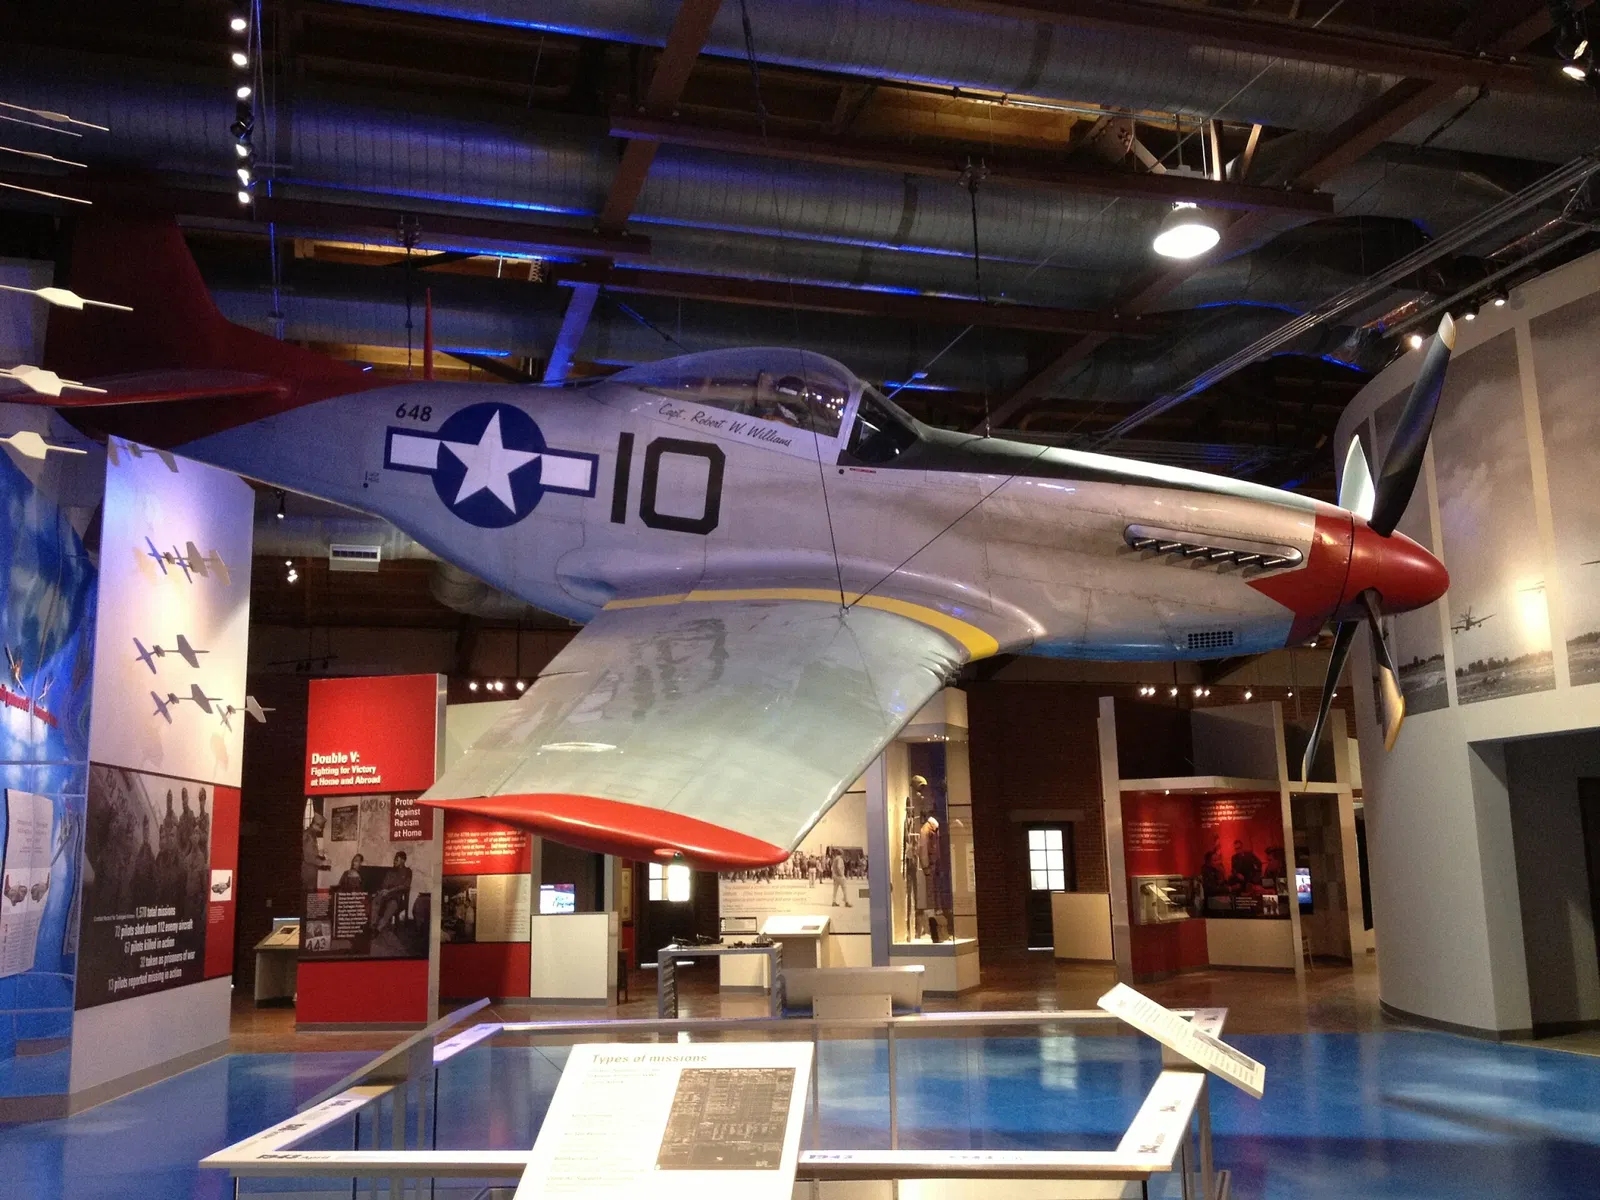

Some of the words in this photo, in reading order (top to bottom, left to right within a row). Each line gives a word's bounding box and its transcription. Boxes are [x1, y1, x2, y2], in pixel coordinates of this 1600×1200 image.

[396, 402, 432, 422] 648
[658, 403, 686, 420] Capt.
[690, 410, 726, 429] Robert
[728, 420, 747, 434] W.
[747, 426, 792, 447] Williams
[610, 432, 726, 535] 10
[311, 752, 348, 764] Double
[350, 751, 360, 762] V:
[310, 766, 339, 777] Fighting
[340, 766, 350, 774] for
[352, 765, 376, 774] Victory
[319, 778, 340, 786] Home
[340, 776, 354, 785] and
[355, 776, 381, 784] Abroad
[395, 798, 417, 806] Prote
[395, 808, 420, 818] Against
[394, 819, 419, 827] Racism
[402, 829, 422, 837] Home
[147, 906, 157, 918] total
[158, 905, 176, 916] missions
[121, 924, 134, 940] pilots
[135, 923, 145, 935] shot
[145, 922, 157, 934] down
[165, 922, 178, 933] enemy
[179, 918, 193, 930] aircraft
[130, 939, 144, 956] pilots
[144, 938, 156, 950] killed
[157, 938, 162, 948] in
[162, 936, 175, 948] action
[146, 955, 158, 967] taken
[158, 956, 164, 964] as
[164, 952, 182, 967] prisoners
[183, 950, 188, 960] of
[114, 977, 128, 993] pilots
[128, 972, 148, 989] reported
[148, 970, 164, 982] missing
[165, 970, 169, 979] in
[169, 968, 182, 978] action
[593, 1054, 629, 1064] Types
[633, 1053, 647, 1063] of
